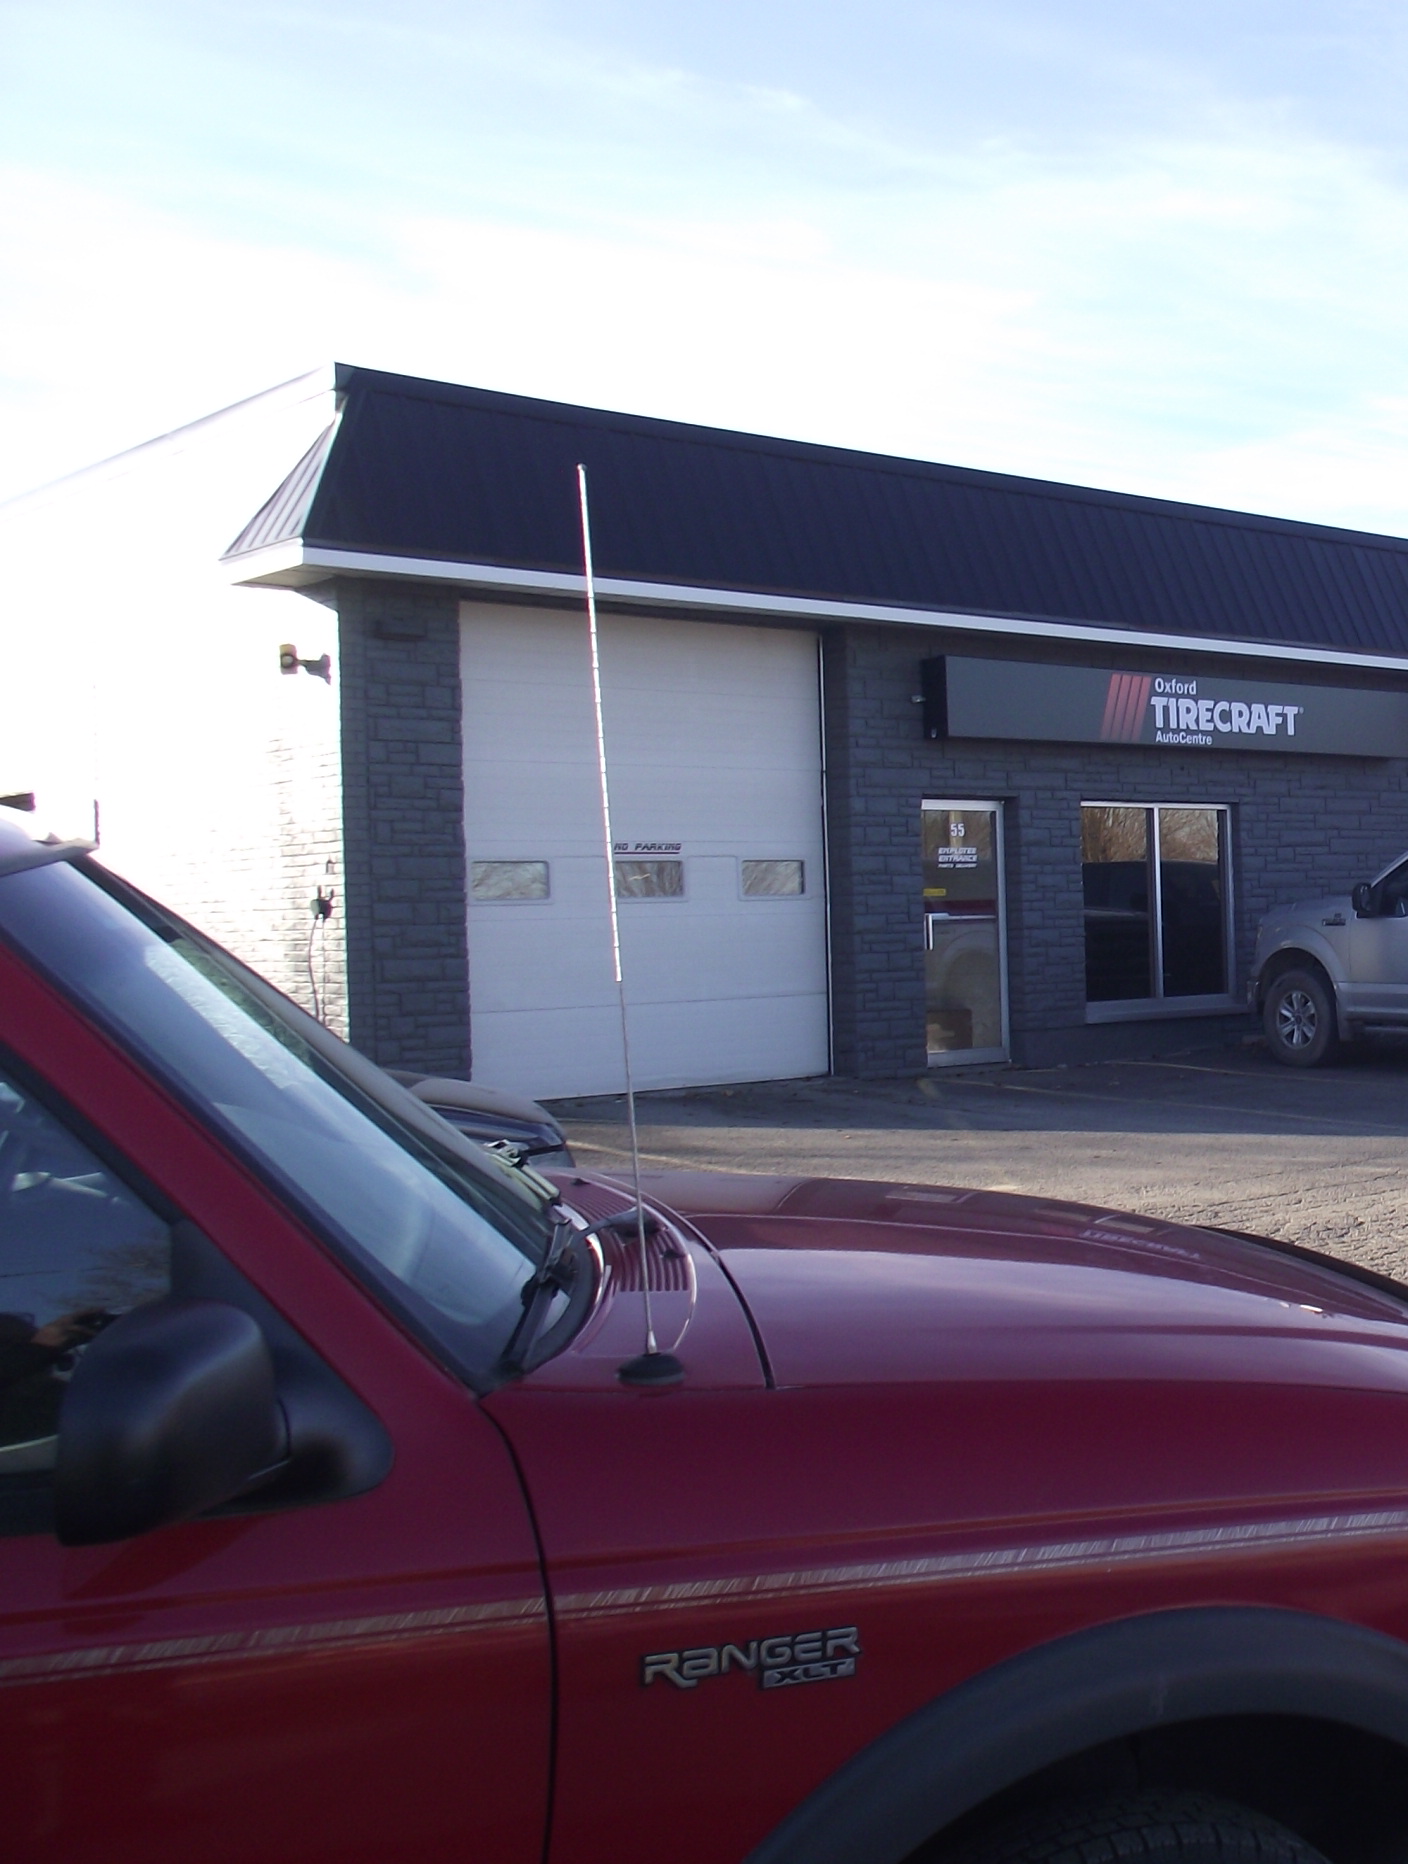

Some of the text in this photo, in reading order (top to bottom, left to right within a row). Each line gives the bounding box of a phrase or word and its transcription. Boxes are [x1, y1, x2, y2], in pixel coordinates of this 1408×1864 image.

[1154, 677, 1197, 695] Oxford
[1150, 696, 1299, 736] TIRECRAFT
[1155, 730, 1213, 745] AutoCentre
[950, 823, 965, 837] 55
[644, 1626, 860, 1688] RANGER
[773, 1660, 848, 1684] XLT
